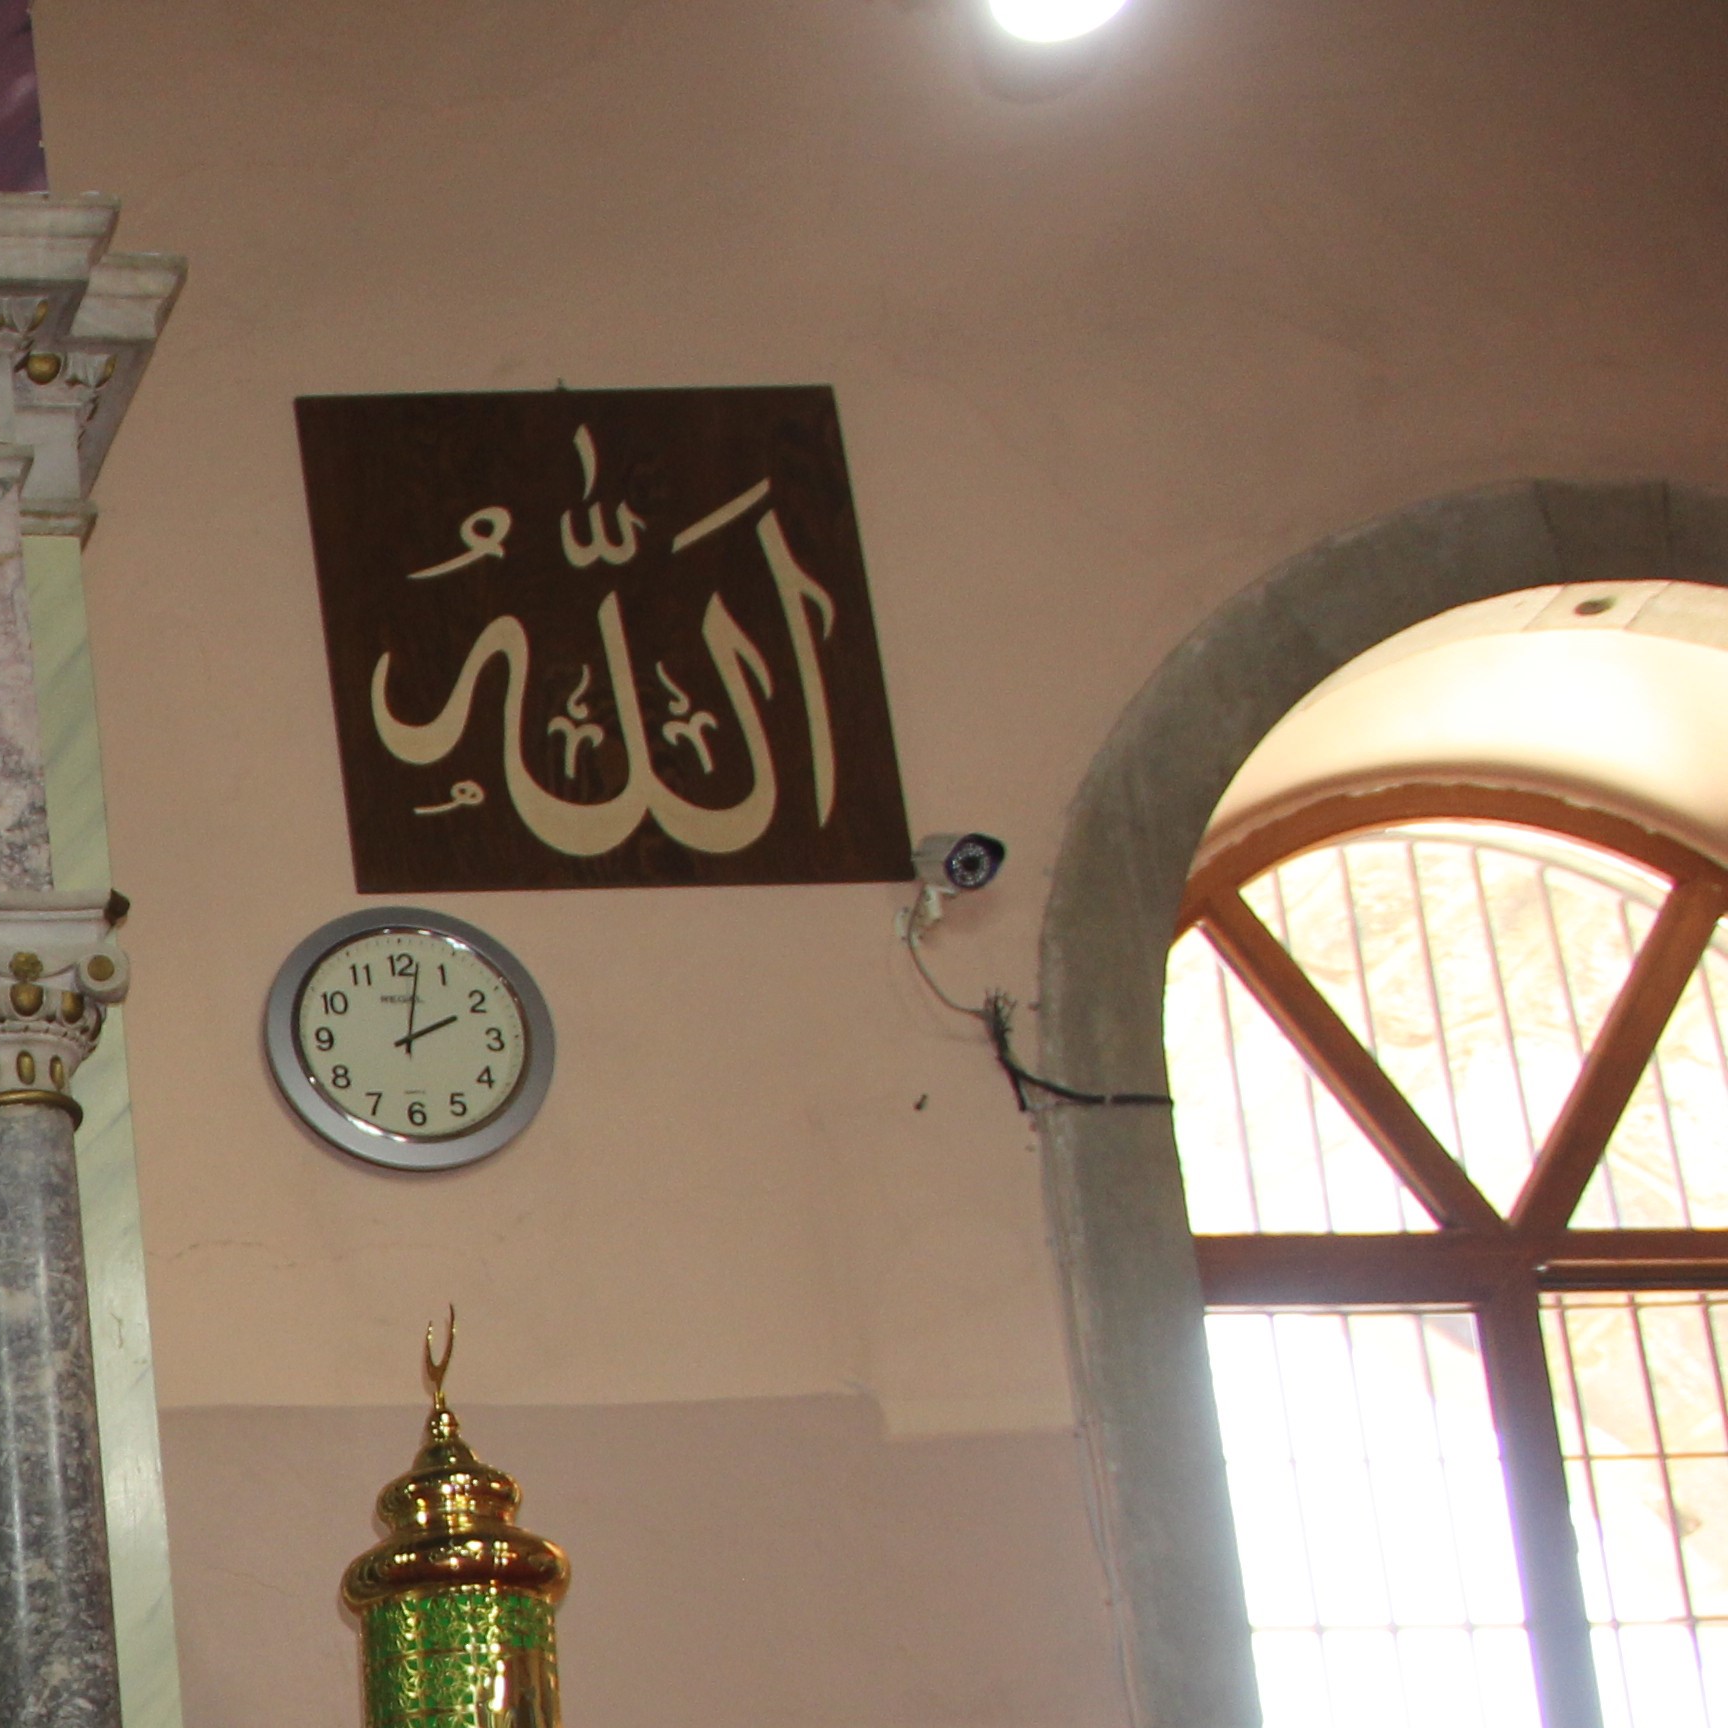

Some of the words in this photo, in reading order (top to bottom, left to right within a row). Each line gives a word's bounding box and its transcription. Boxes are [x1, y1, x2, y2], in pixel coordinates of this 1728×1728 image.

[349, 963, 372, 986] 11
[387, 953, 414, 977] 12
[438, 963, 447, 986] 1
[321, 990, 348, 1015] 10
[468, 989, 487, 1013] 2
[315, 1027, 334, 1051] 9
[485, 1027, 505, 1052] 3
[332, 1065, 351, 1089] 8
[477, 1065, 495, 1089] 4
[365, 1092, 383, 1116] 7
[407, 1101, 427, 1126] 6
[449, 1093, 467, 1117] 5
